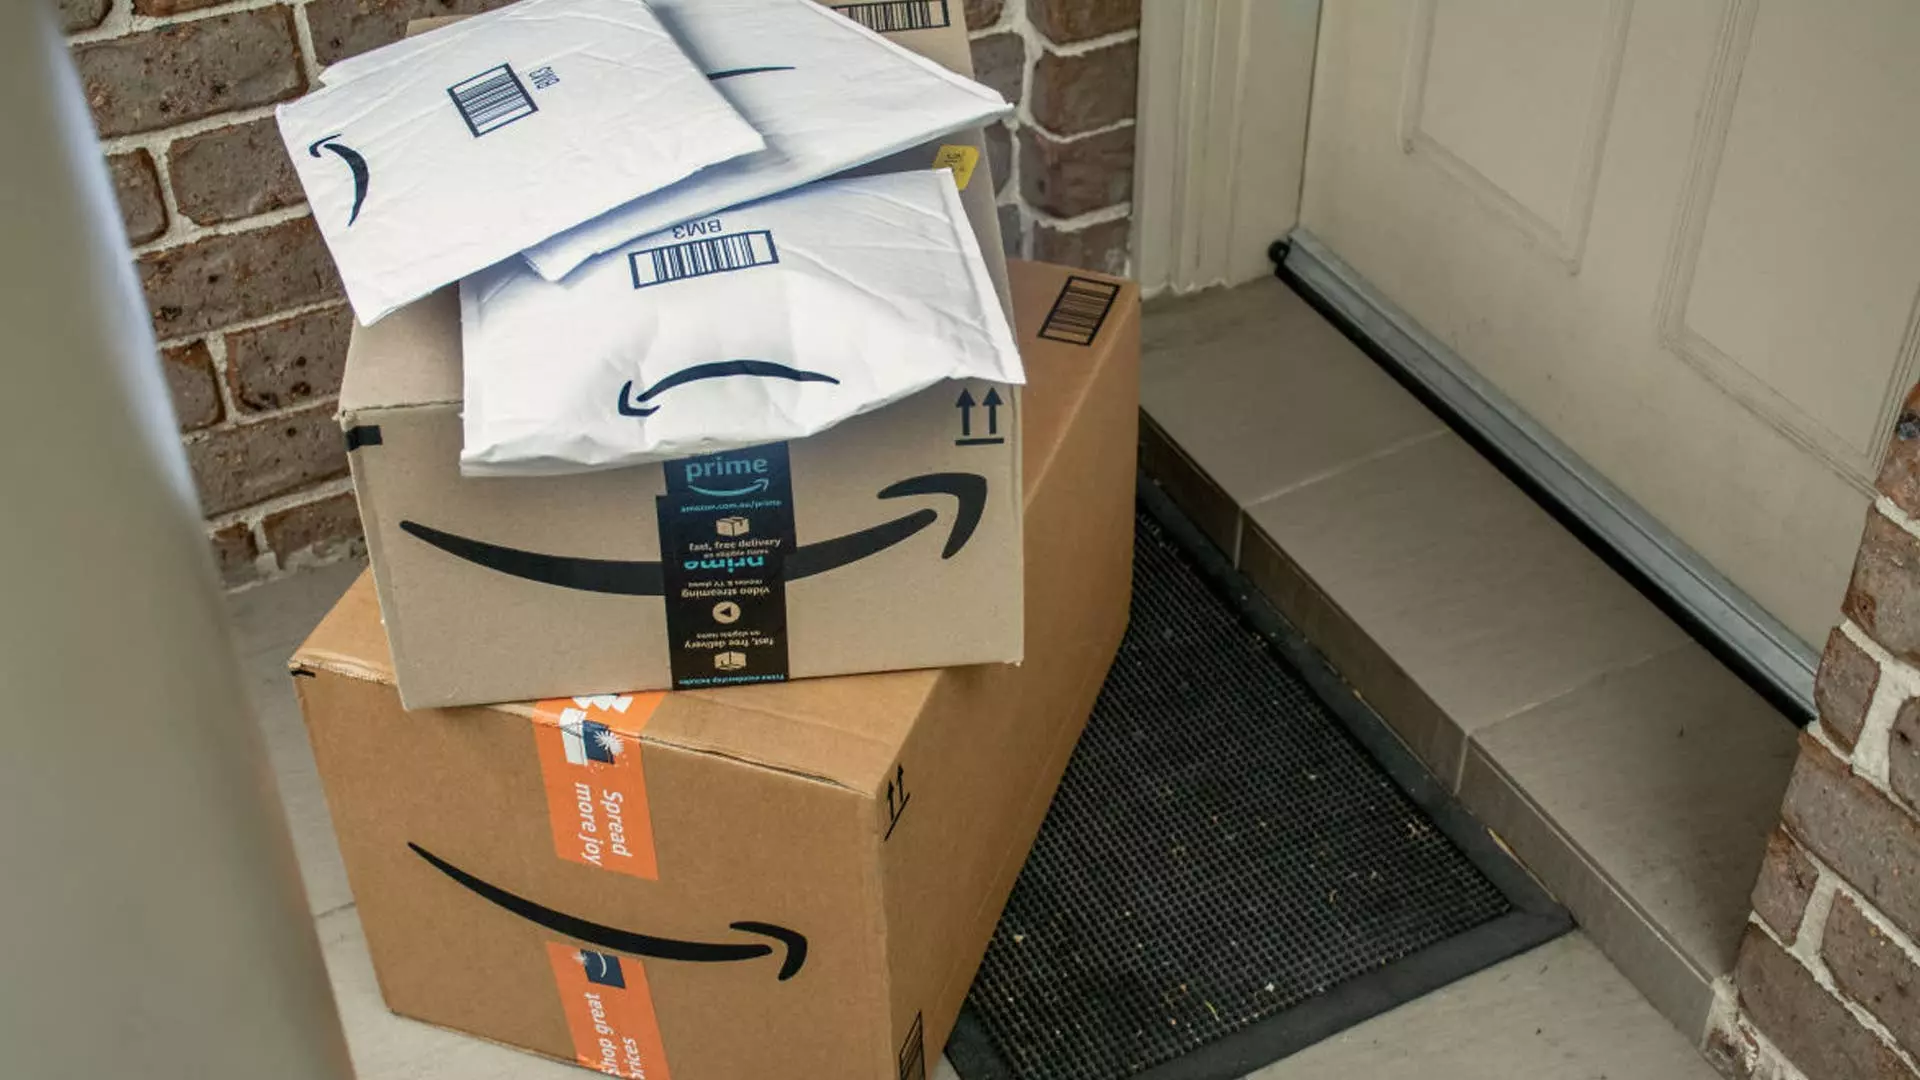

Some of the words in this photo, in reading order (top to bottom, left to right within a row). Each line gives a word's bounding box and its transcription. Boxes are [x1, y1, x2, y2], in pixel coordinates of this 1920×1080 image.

[672, 219, 722, 239] BM3
[685, 456, 768, 482] prime
[680, 500, 782, 512] amazon.com.au/prime
[689, 542, 712, 552] fast,
[714, 541, 737, 549] free
[738, 538, 781, 548] delivery
[681, 588, 737, 598] streaming
[740, 587, 770, 597] video
[684, 639, 726, 649] delivery
[729, 639, 748, 647] free
[751, 637, 774, 646] fast,
[574, 782, 597, 833] more
[600, 789, 634, 858] Spread
[578, 833, 604, 867] joy
[584, 992, 615, 1035] great
